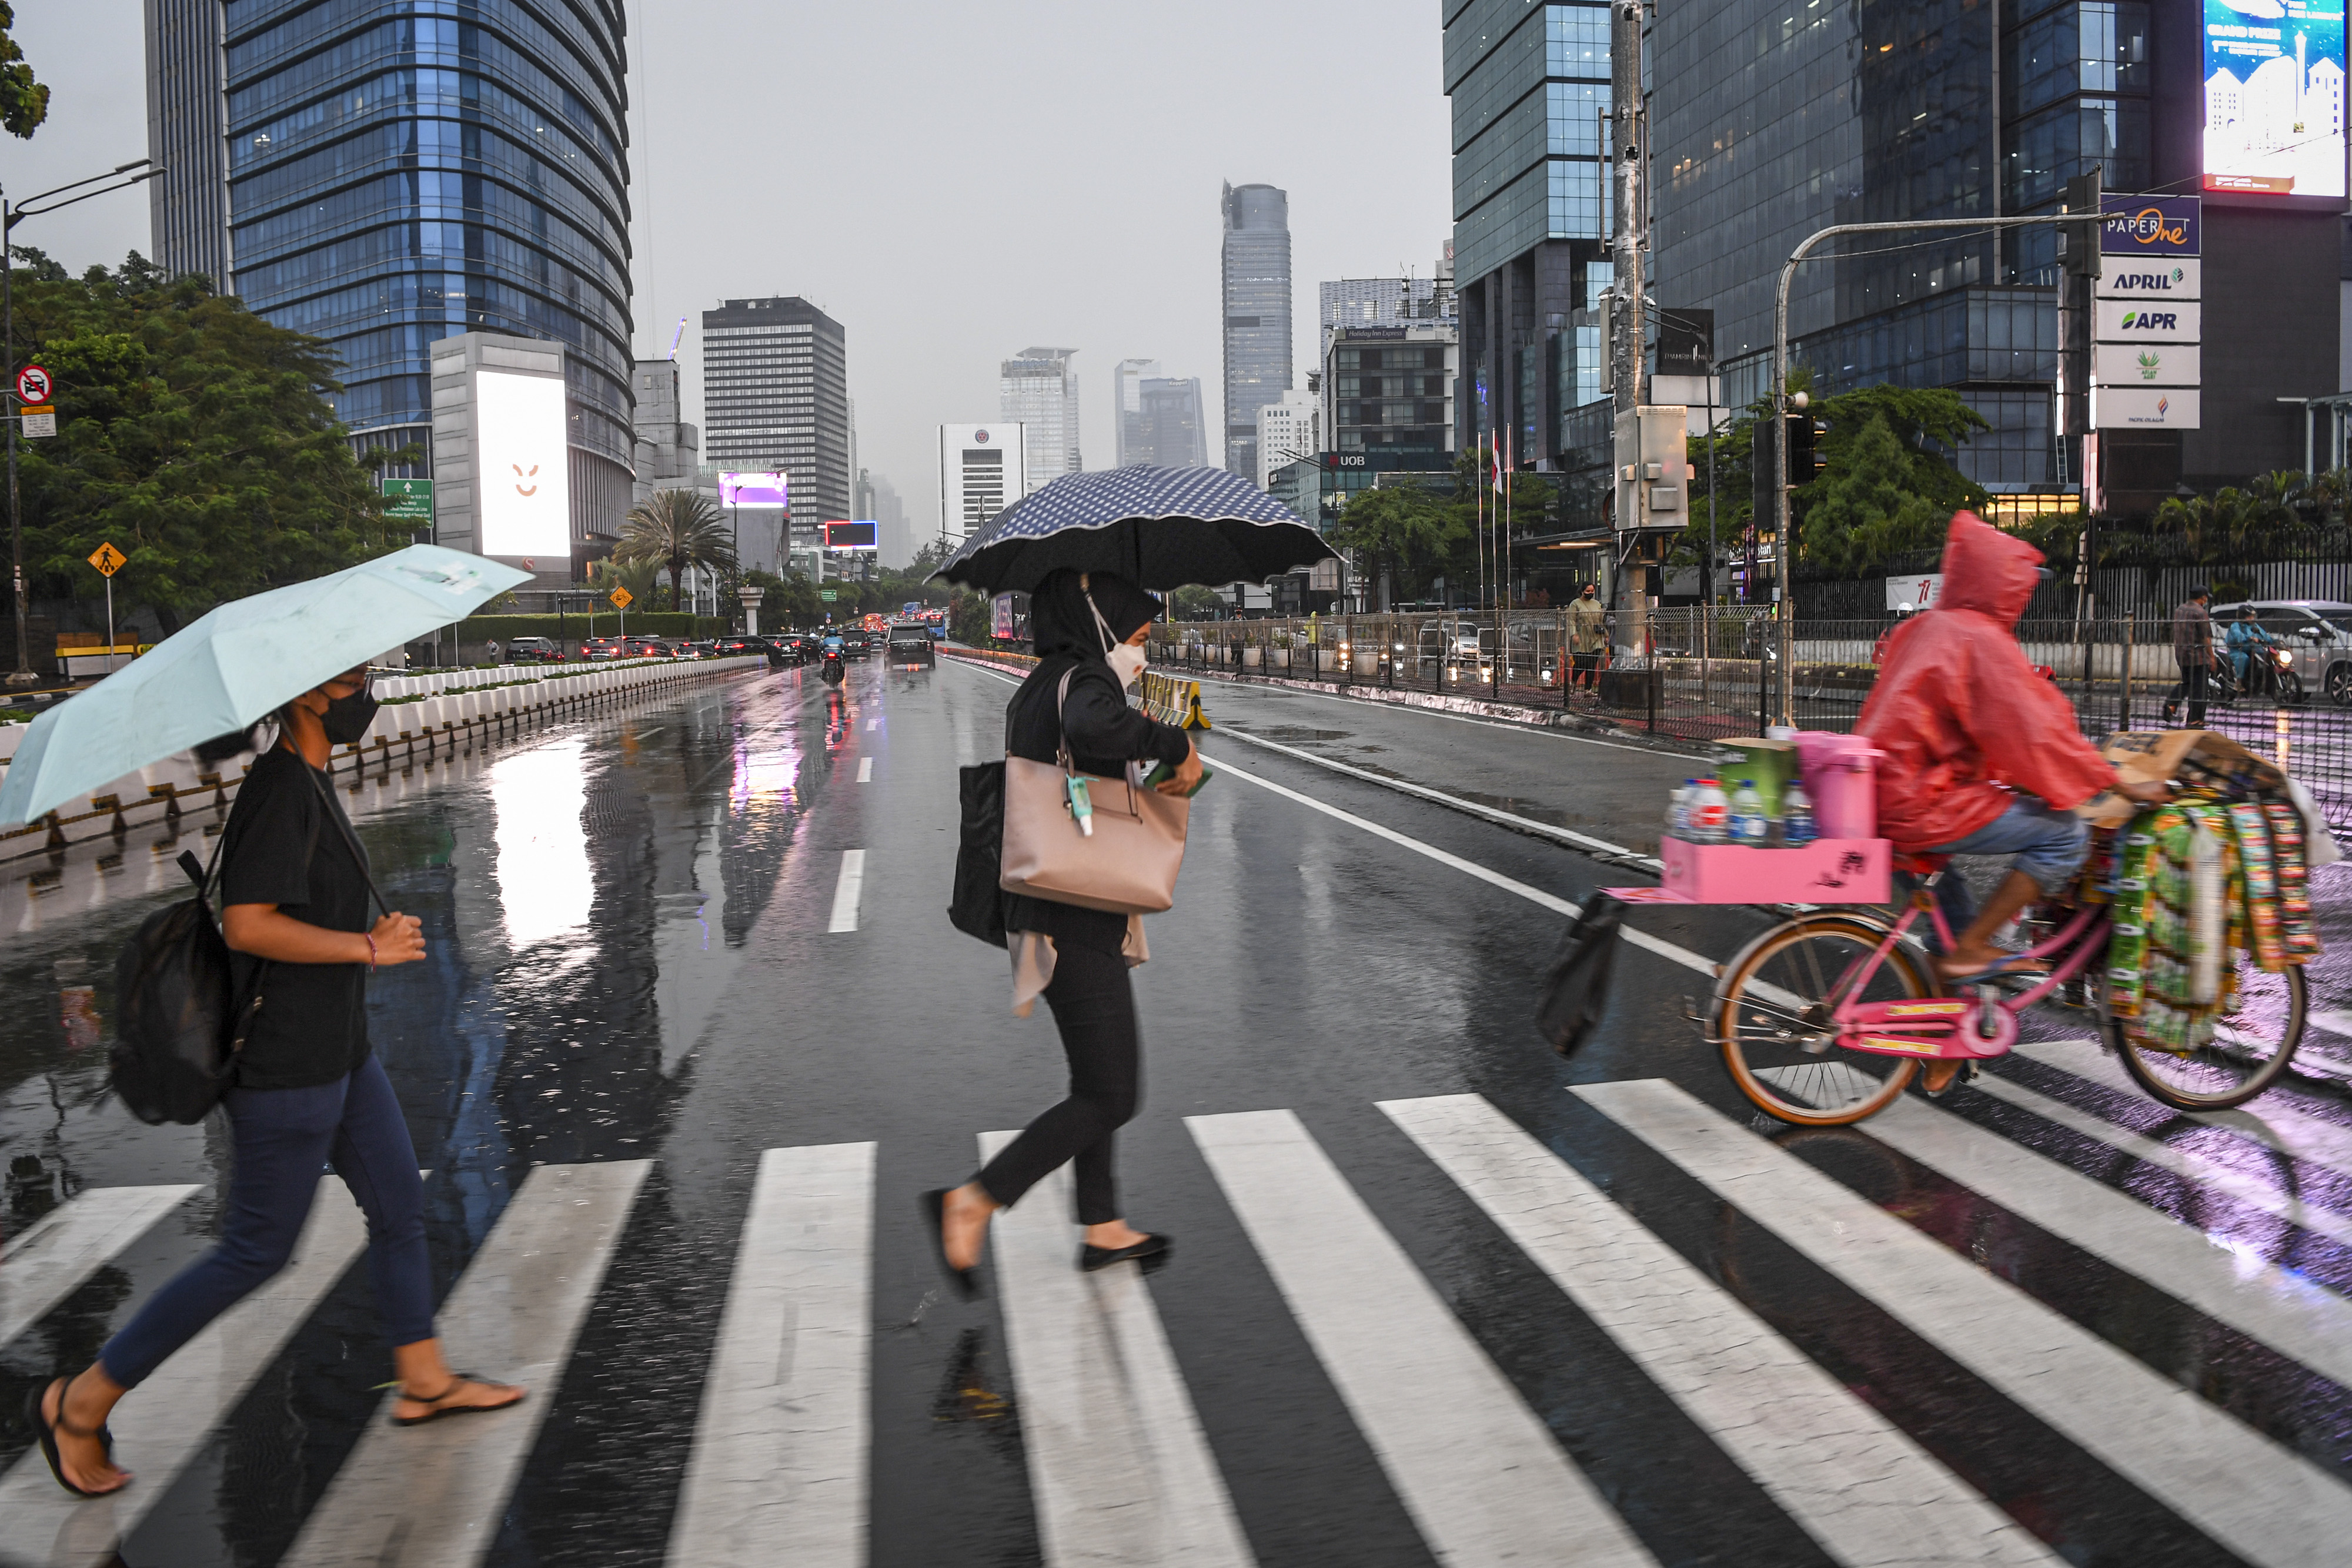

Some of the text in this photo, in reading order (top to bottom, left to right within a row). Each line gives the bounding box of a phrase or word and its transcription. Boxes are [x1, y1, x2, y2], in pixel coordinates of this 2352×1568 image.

[2113, 274, 2172, 289] APRIL
[2135, 313, 2177, 329] APR
[1340, 456, 1365, 466] UOB
